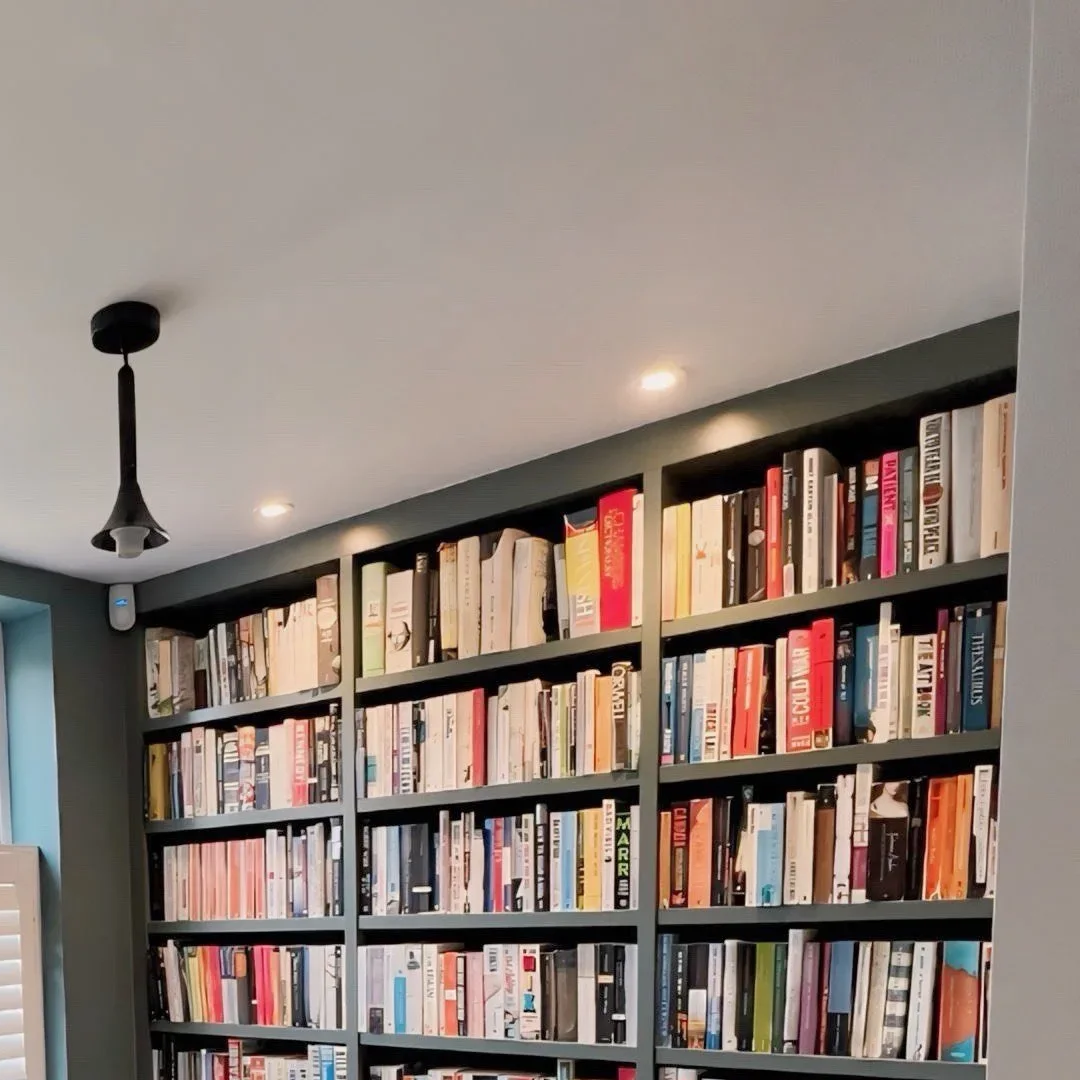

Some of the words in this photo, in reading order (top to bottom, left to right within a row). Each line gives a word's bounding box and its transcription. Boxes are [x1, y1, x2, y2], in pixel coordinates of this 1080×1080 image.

[882, 458, 897, 511] PATIENT
[792, 647, 810, 679] WAR
[970, 632, 985, 706] THESAURUS
[612, 665, 626, 719] ORWELL
[792, 679, 811, 716] COLD
[916, 686, 932, 718] BOOK
[295, 724, 306, 782] KENNEDY
[616, 817, 631, 877] MARR
